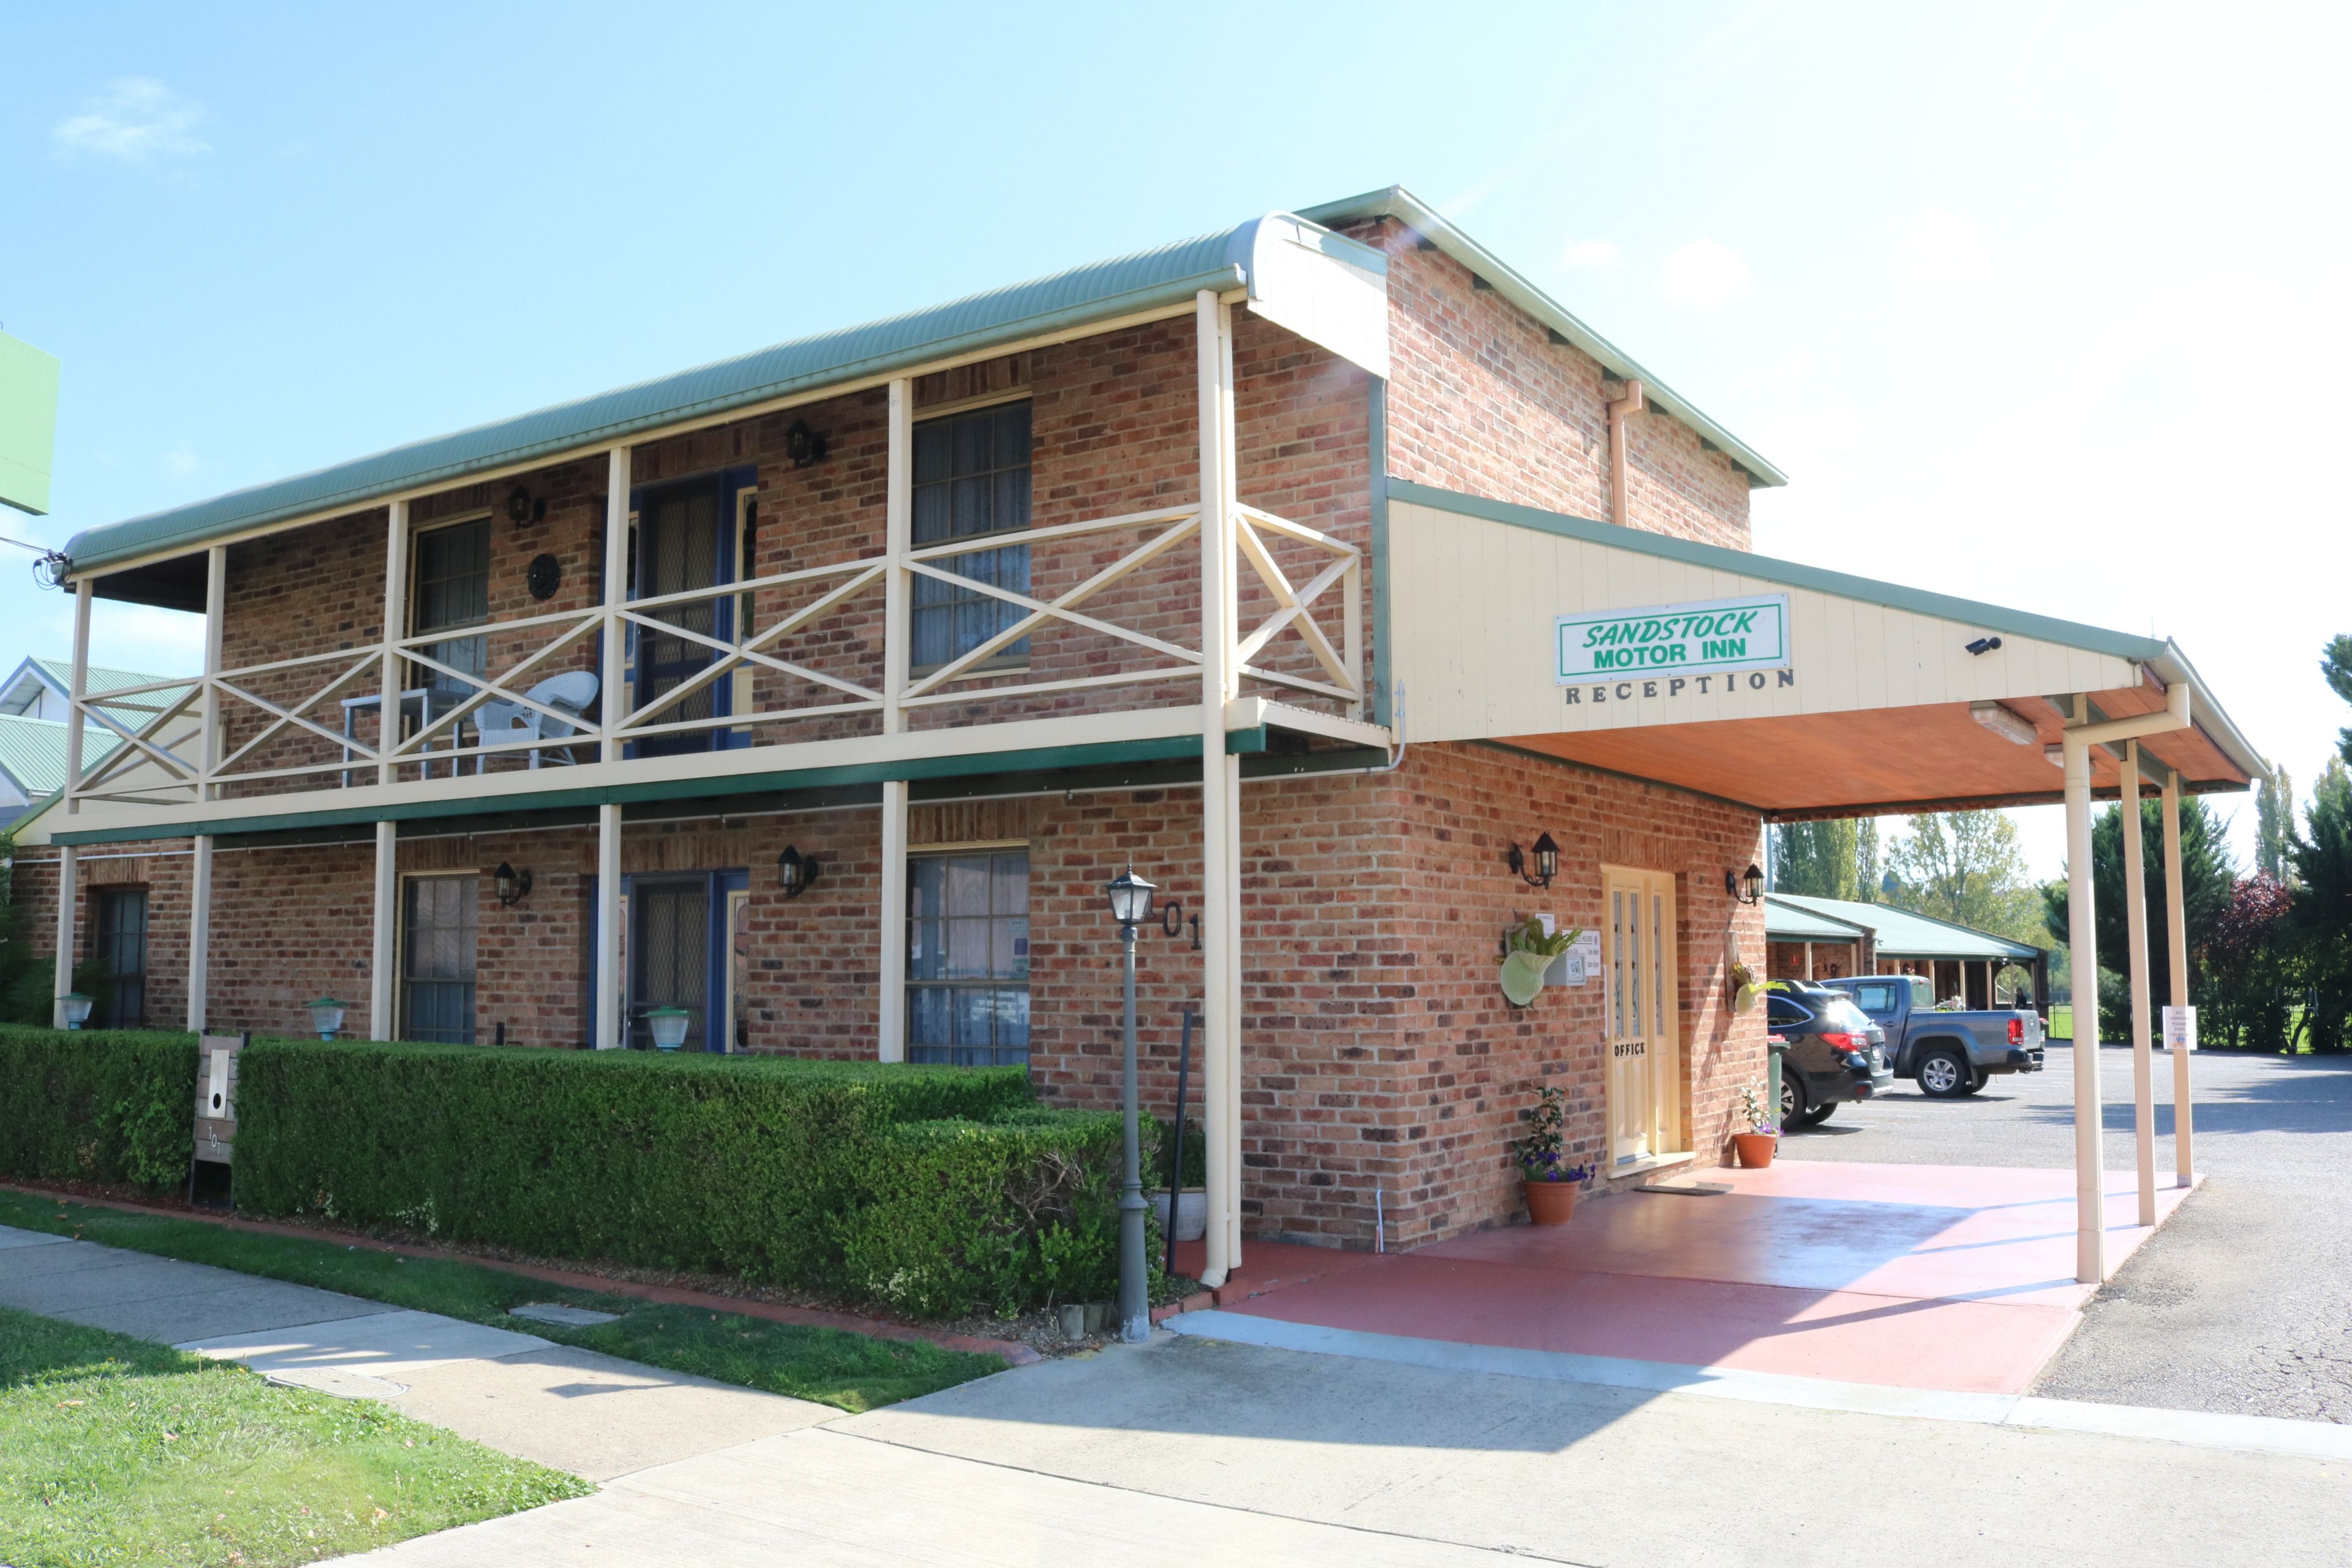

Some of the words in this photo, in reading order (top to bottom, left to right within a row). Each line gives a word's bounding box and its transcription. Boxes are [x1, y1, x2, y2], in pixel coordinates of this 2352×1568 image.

[1582, 611, 1758, 648] SANDSTOCK
[1594, 643, 1686, 669] MOTOR
[1702, 638, 1746, 660] INN
[1566, 668, 1795, 704] RECEPTION
[1615, 1042, 1645, 1057] OFFICE
[209, 1126, 221, 1156] 101
